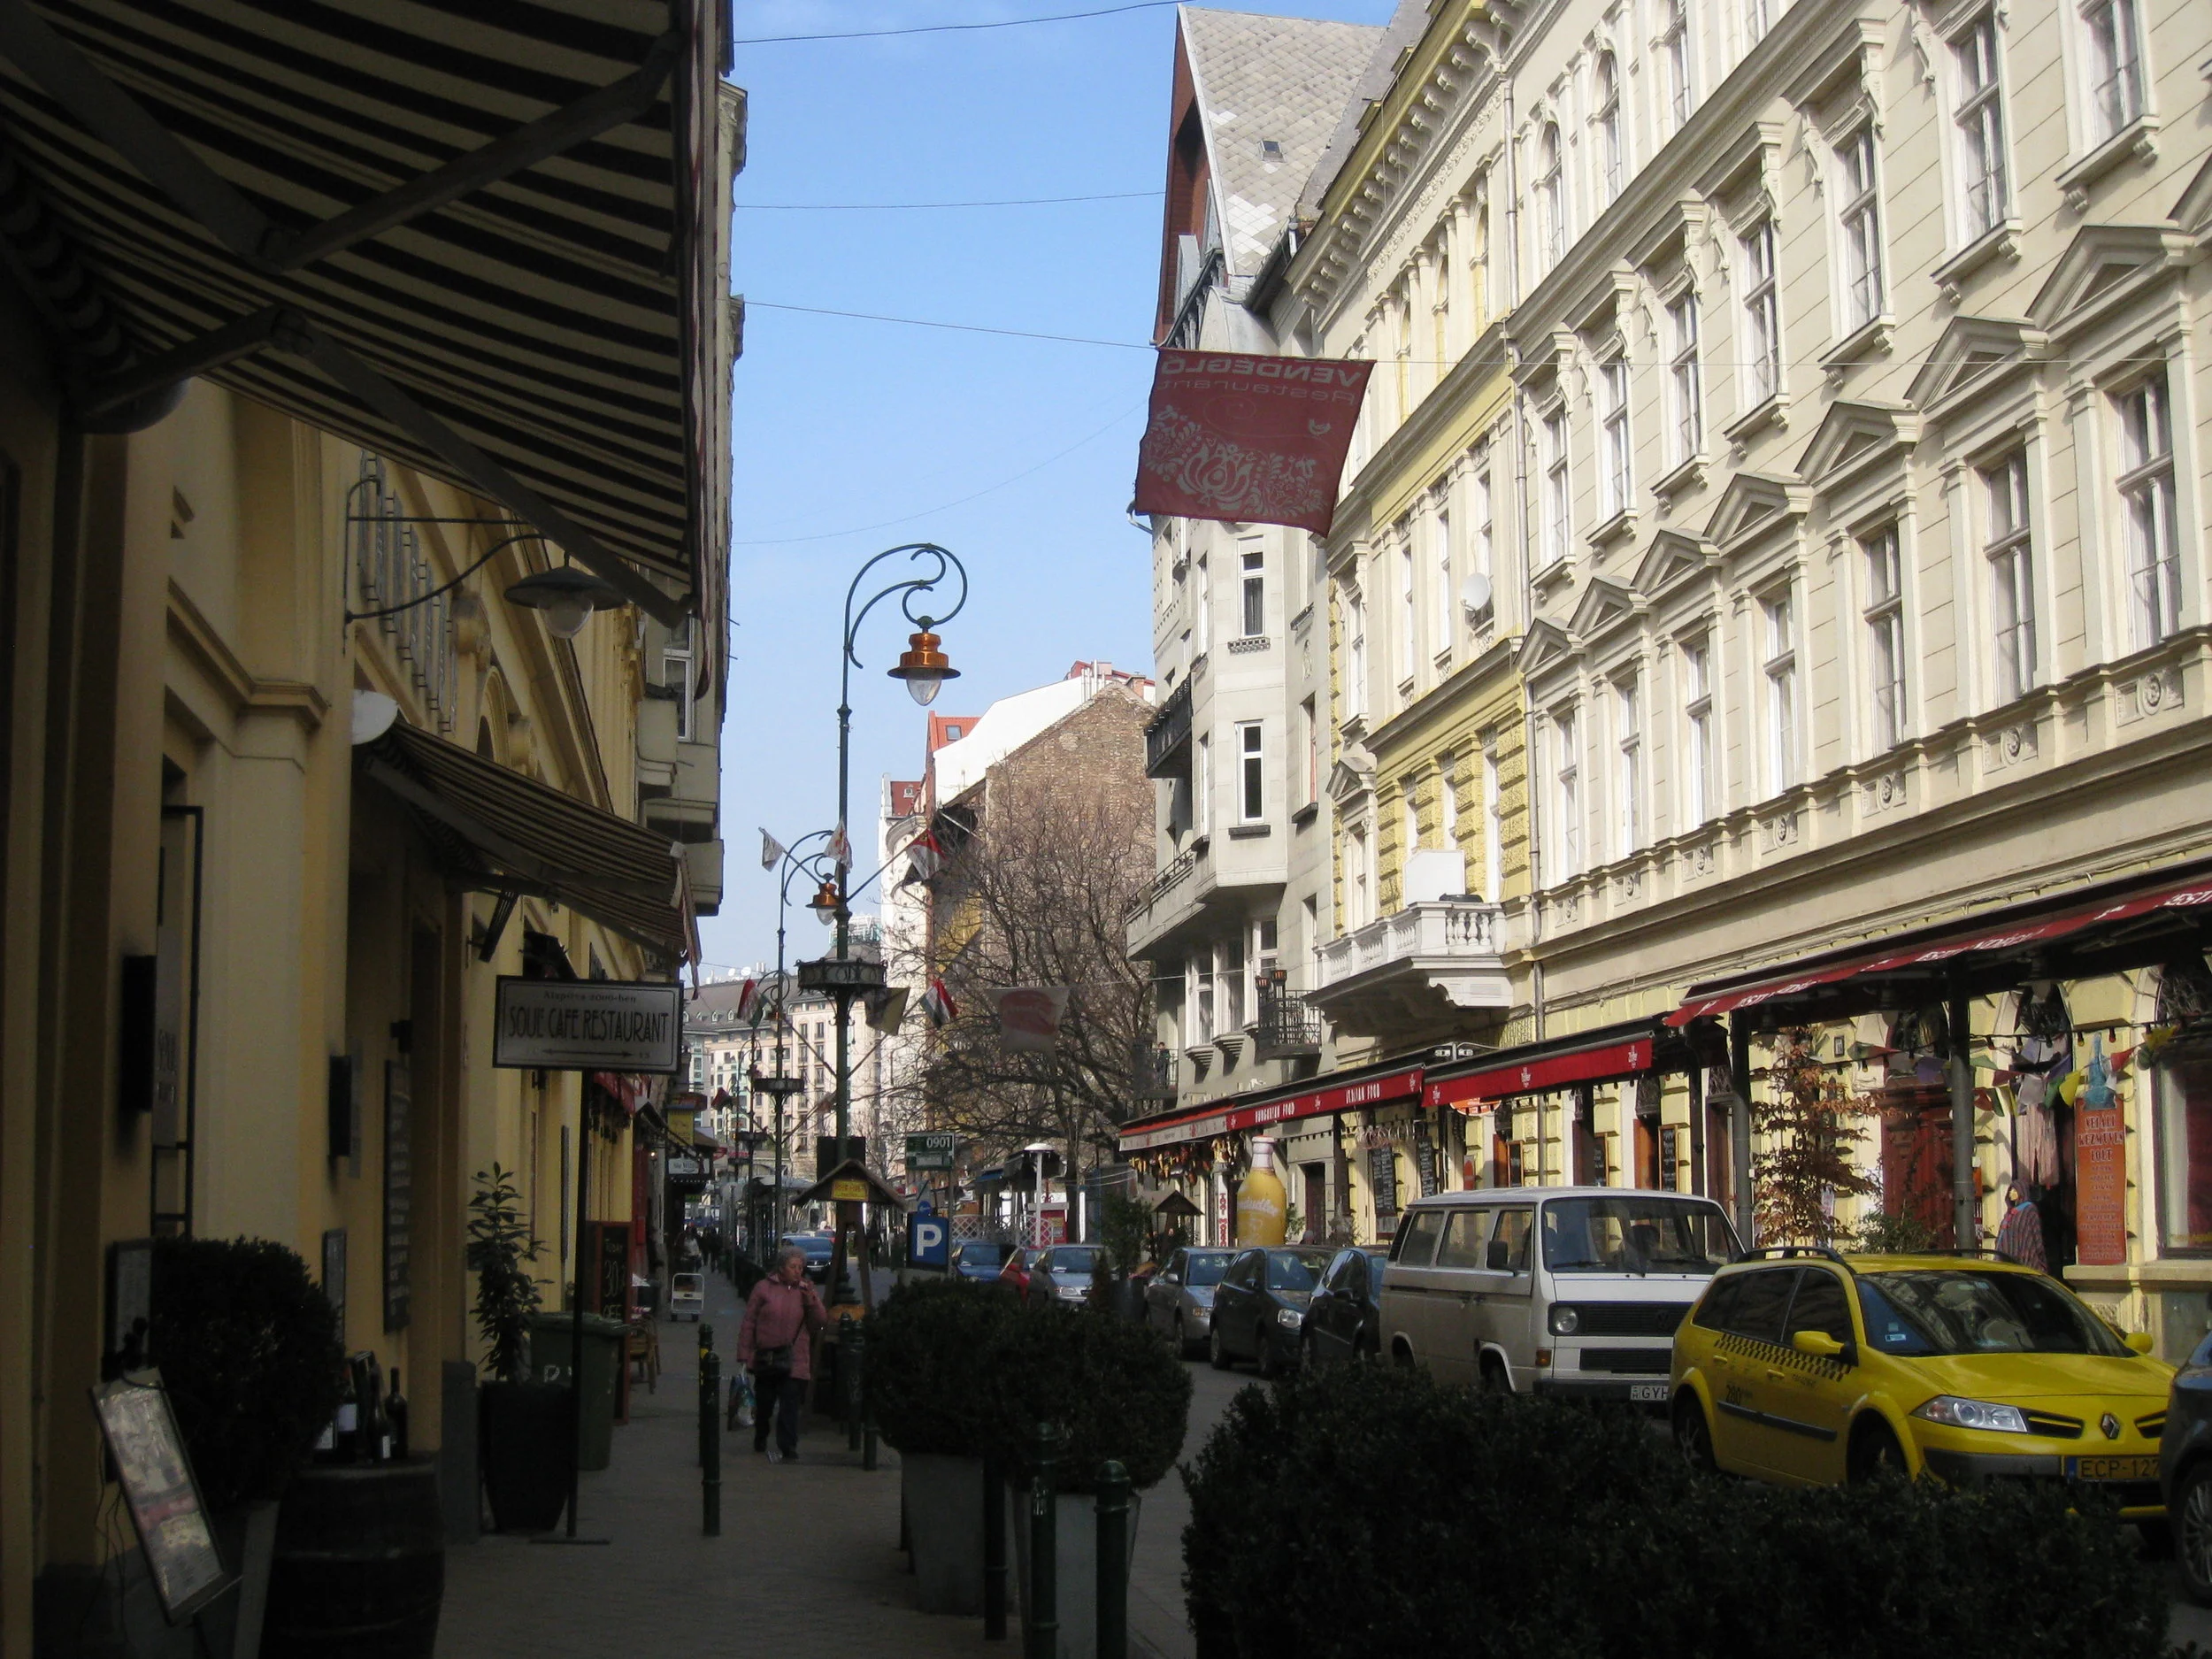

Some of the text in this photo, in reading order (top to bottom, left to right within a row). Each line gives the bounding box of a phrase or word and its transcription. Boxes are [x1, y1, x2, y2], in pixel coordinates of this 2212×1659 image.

[583, 1009, 670, 1043] RESTAURANT
[926, 1136, 950, 1148] 0901
[916, 1224, 942, 1256] P
[2080, 1459, 2161, 1478] ECP-127
